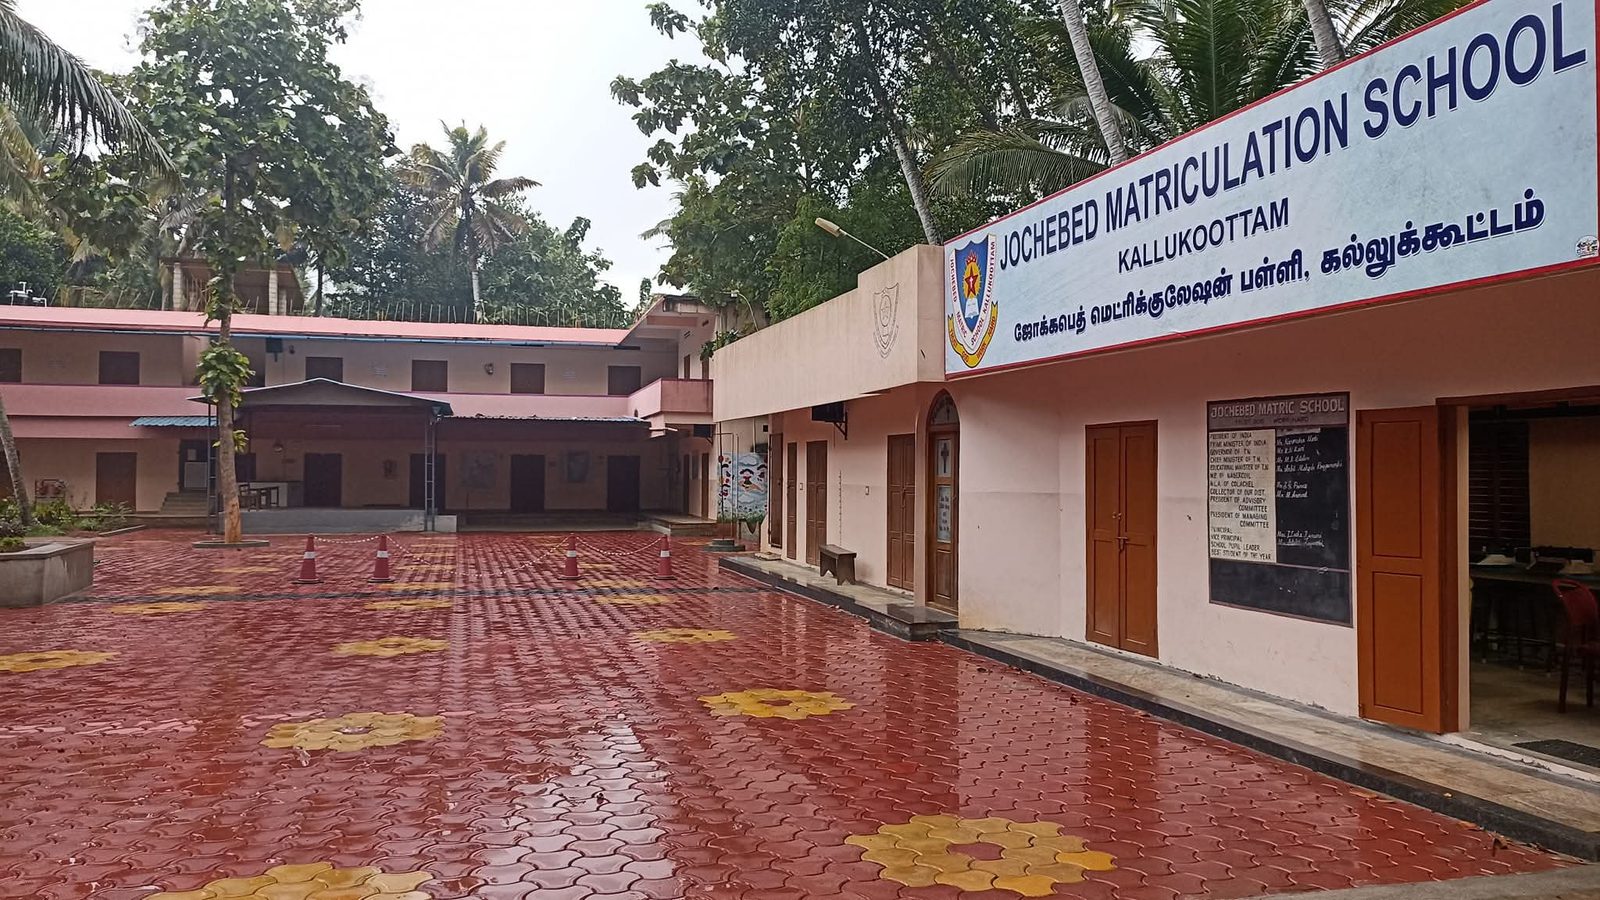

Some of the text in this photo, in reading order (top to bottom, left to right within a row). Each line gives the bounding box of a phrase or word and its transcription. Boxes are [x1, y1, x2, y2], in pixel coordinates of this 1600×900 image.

[1000, 2, 1587, 271] JOCHEBED MATRICULATION SCHOOL
[1118, 197, 1290, 274] KALLUKOOTTAM
[950, 258, 958, 303] JOCHEBED
[982, 241, 996, 314] KALLUKOOTTAM
[1014, 305, 1086, 342] ஜோக்கபெத்
[1090, 267, 1234, 326] மெட்ரிக்குலேஷன்
[1320, 187, 1546, 278] கல்லுக்கூட்டம்
[1210, 399, 1345, 418] JOCHEBED MATRIC SCHOOL
[1238, 504, 1268, 513] COMMITTEE
[1239, 520, 1270, 529] COMMITTEE
[1242, 512, 1268, 520] MANAGING
